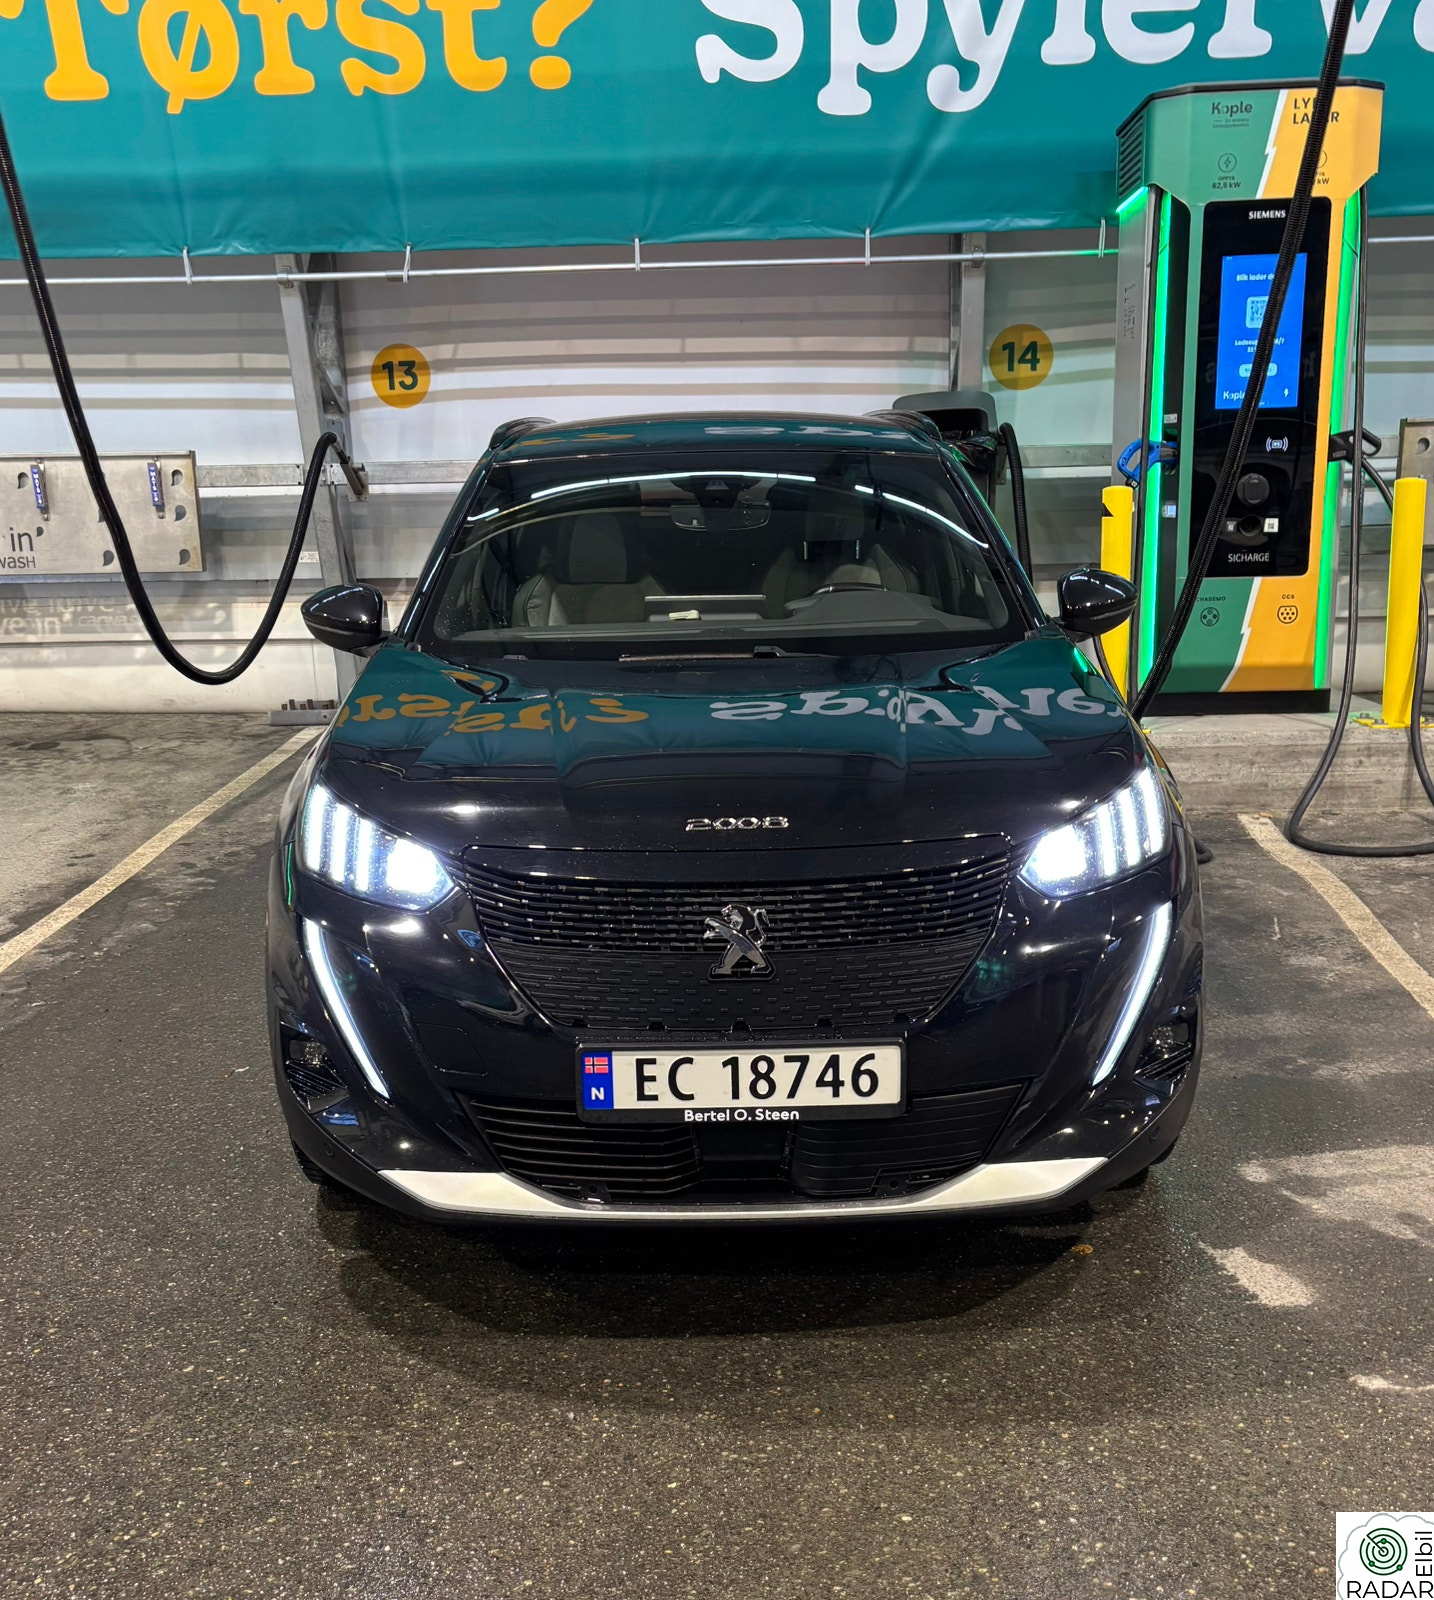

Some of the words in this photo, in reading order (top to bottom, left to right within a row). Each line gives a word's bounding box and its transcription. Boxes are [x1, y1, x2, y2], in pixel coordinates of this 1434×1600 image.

[1211, 100, 1253, 117] Kople
[1293, 97, 1317, 110] LY
[1293, 111, 1340, 125] LAR
[1248, 209, 1287, 220] SIEMENS
[1002, 340, 1041, 372] 14
[381, 360, 419, 391] 13
[9, 527, 34, 552] in
[1227, 552, 1270, 563] SICHARGE
[685, 816, 789, 831] 2008
[635, 1057, 695, 1101] EC
[721, 1053, 879, 1099] 18746
[591, 1087, 605, 1101] N
[684, 1110, 730, 1122] Bertel
[734, 1109, 752, 1121] O.
[755, 1108, 800, 1121] Steen
